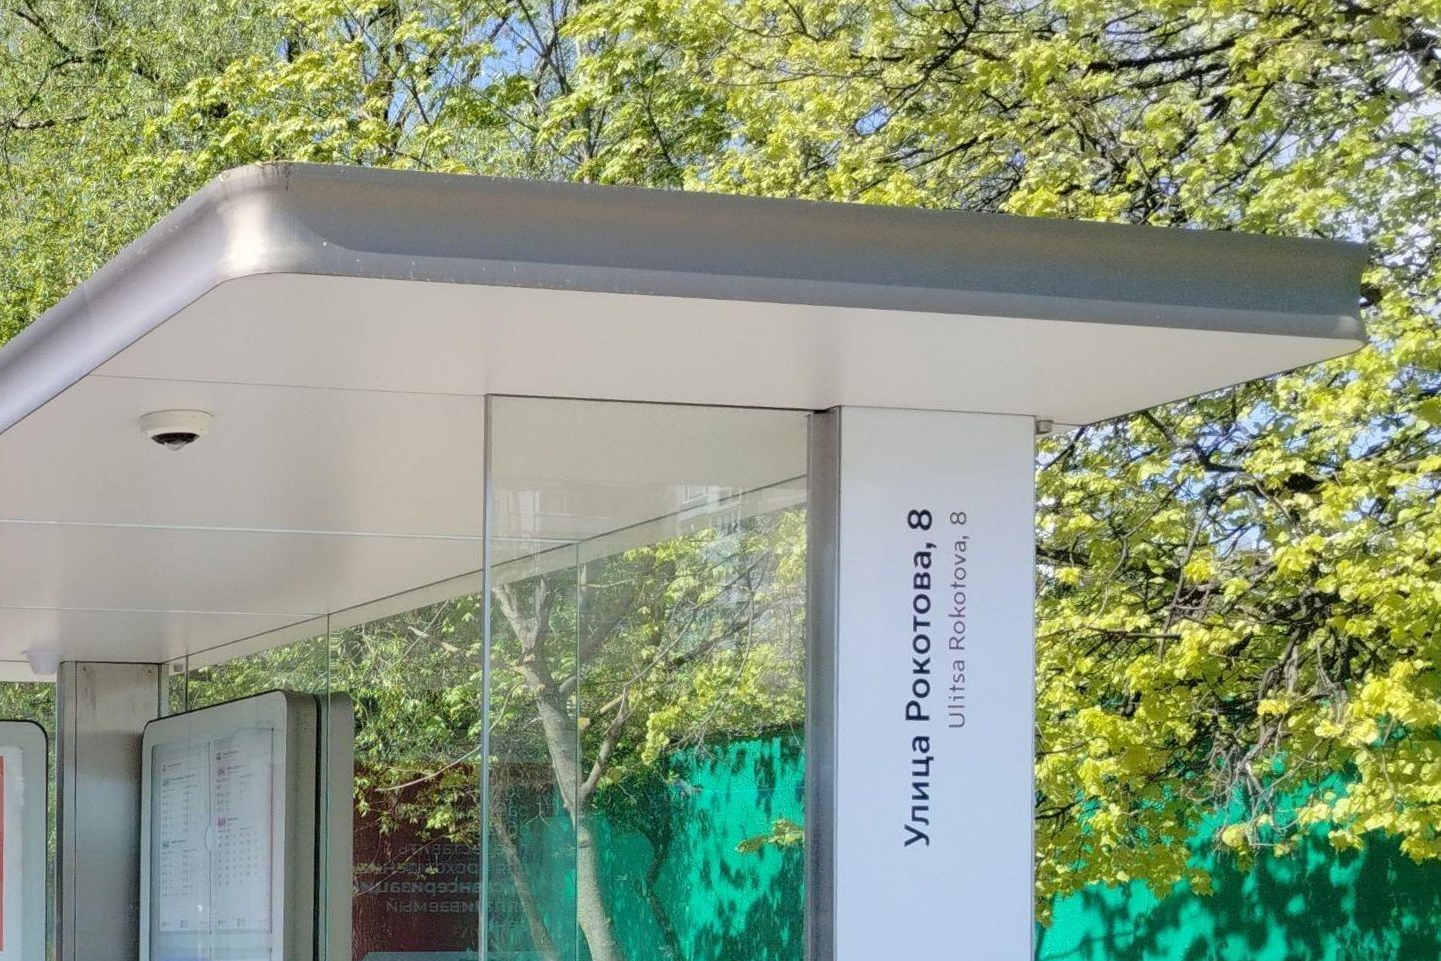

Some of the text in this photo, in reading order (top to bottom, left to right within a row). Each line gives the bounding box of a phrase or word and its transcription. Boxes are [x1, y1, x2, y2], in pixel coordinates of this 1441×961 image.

[904, 508, 938, 847] Улица Рокотова, 8
[948, 511, 970, 729] Ulitsa Rokotova, 8
